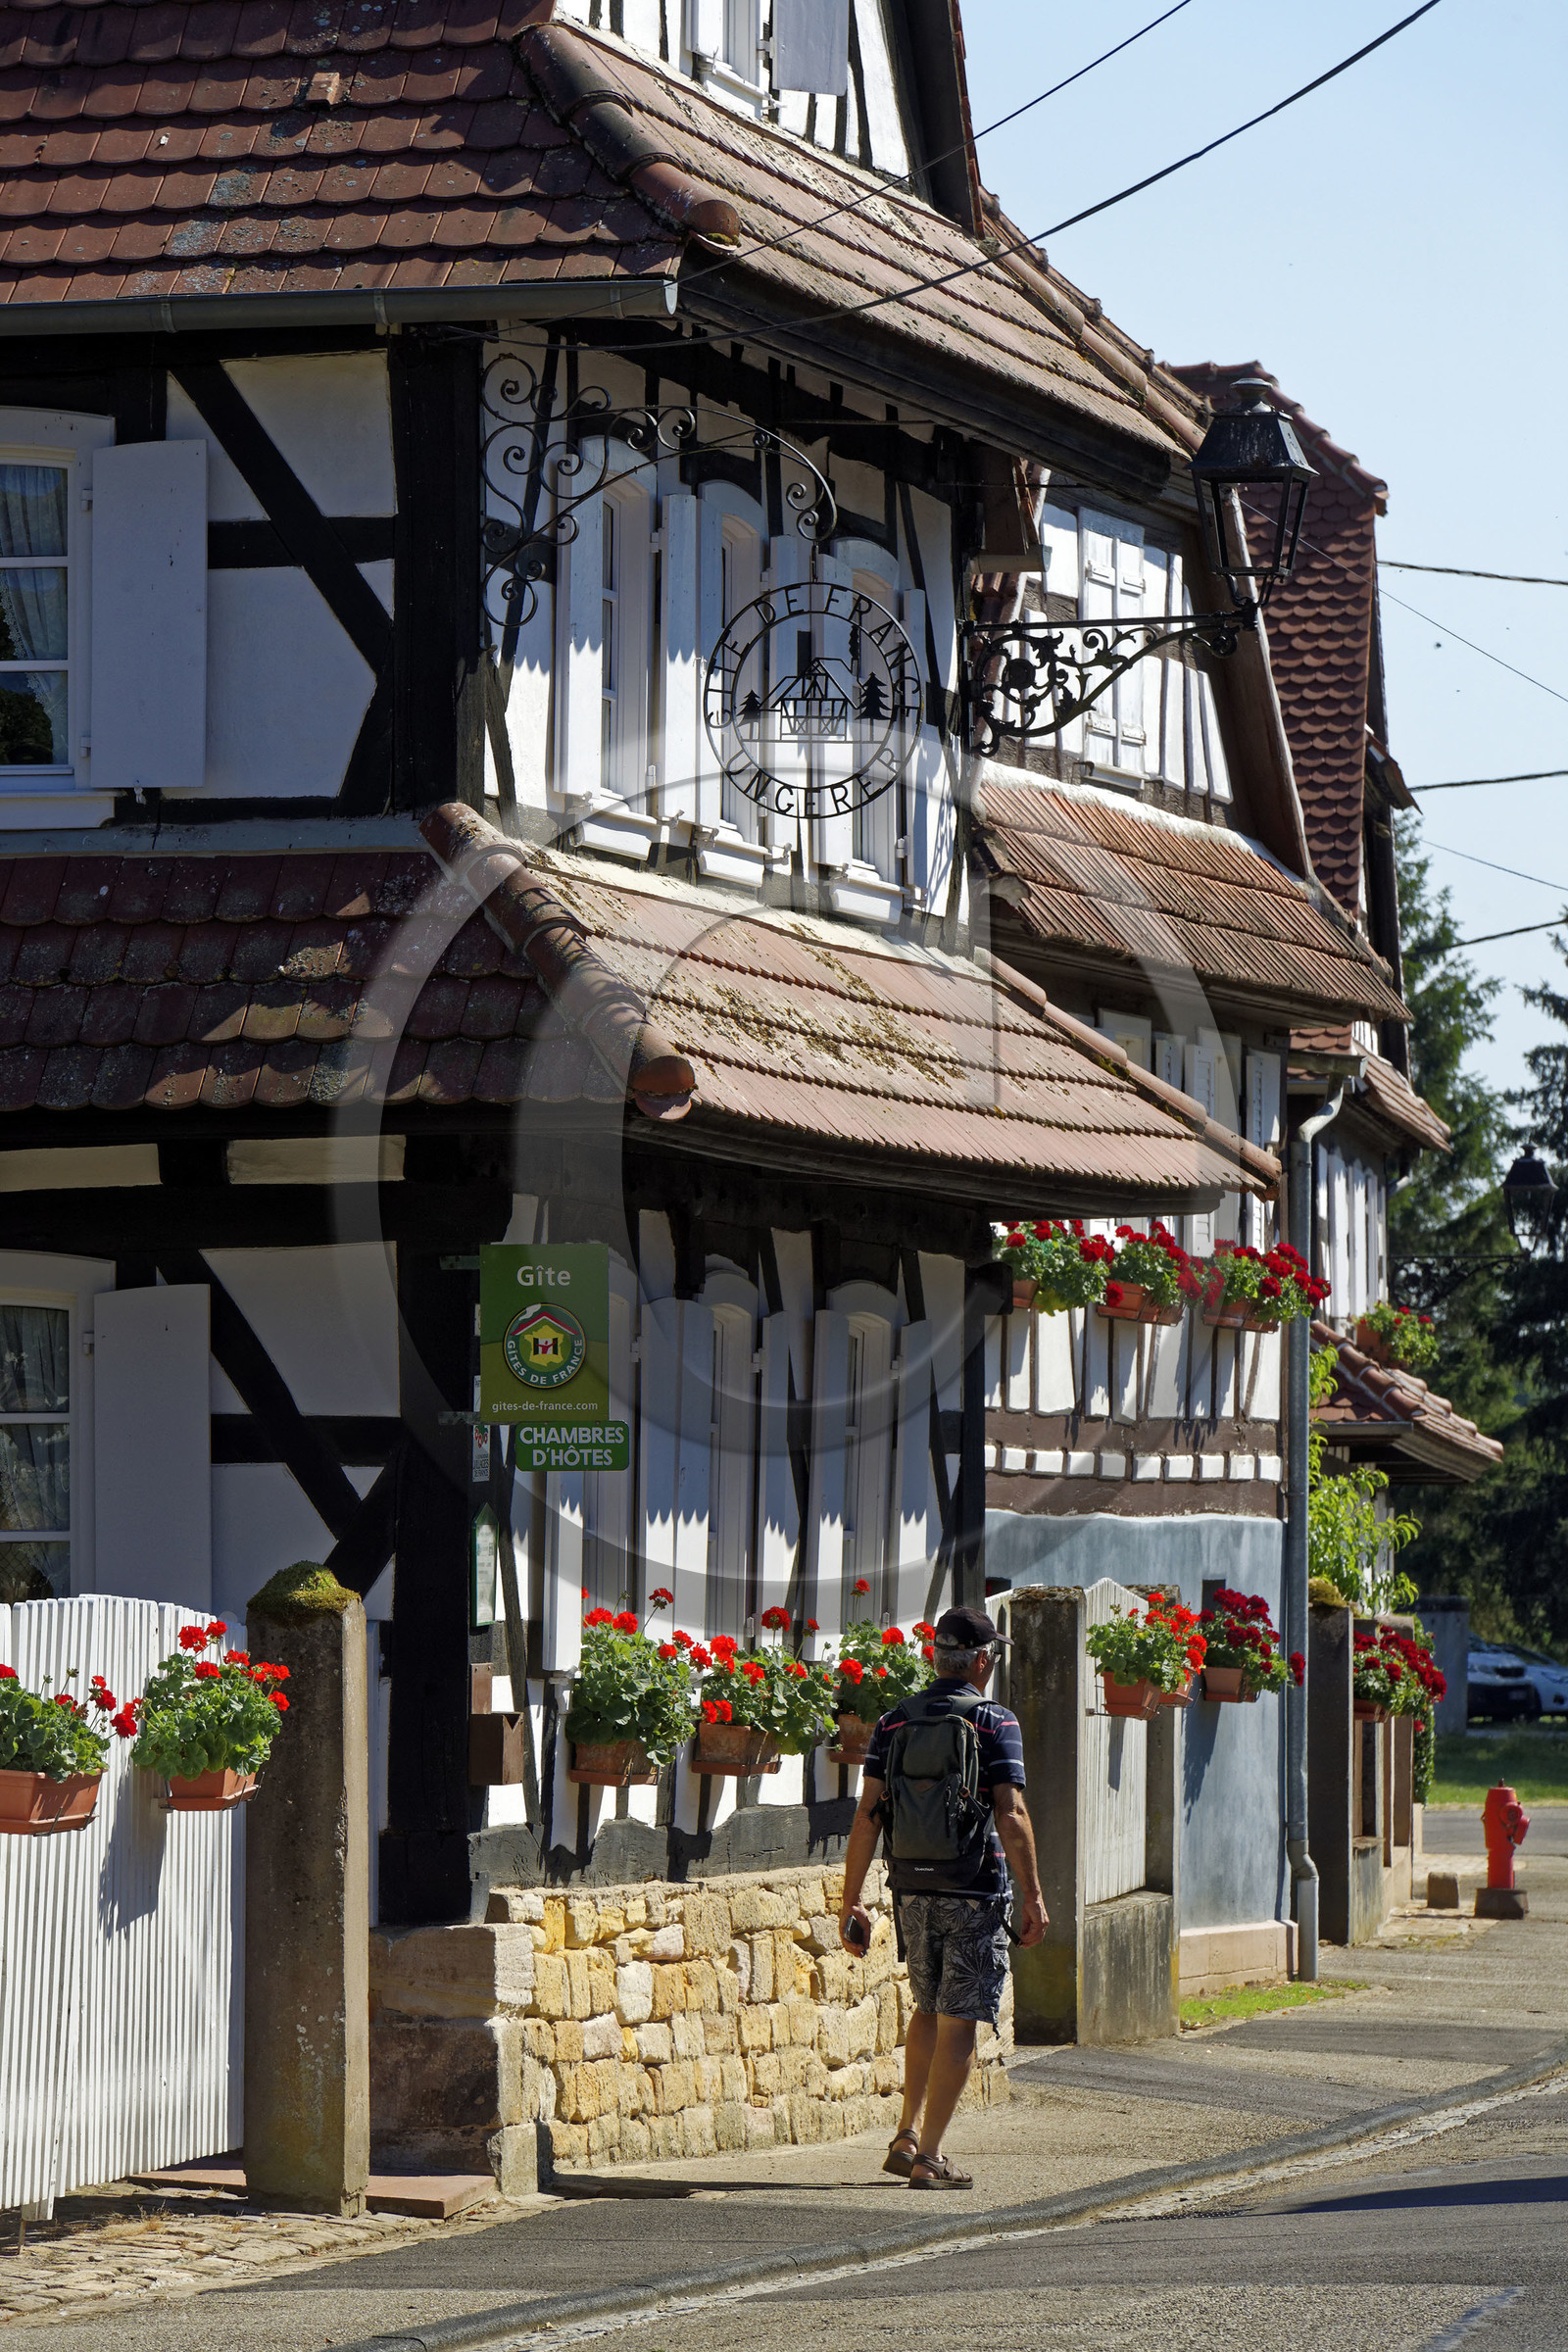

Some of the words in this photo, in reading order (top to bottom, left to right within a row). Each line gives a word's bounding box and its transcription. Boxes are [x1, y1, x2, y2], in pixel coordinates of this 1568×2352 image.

[706, 629, 751, 728] GITE
[754, 586, 805, 624] DE
[825, 586, 921, 725] FRANCE
[725, 748, 902, 817] UNGERER
[516, 1265, 571, 1286] Gîte
[530, 1374, 547, 1385] DE
[552, 1339, 583, 1384] FRANCE
[492, 1400, 598, 1412] gites-de-france.com
[519, 1427, 624, 1445] CHAMBRES
[532, 1445, 613, 1466] D'HÔTES
